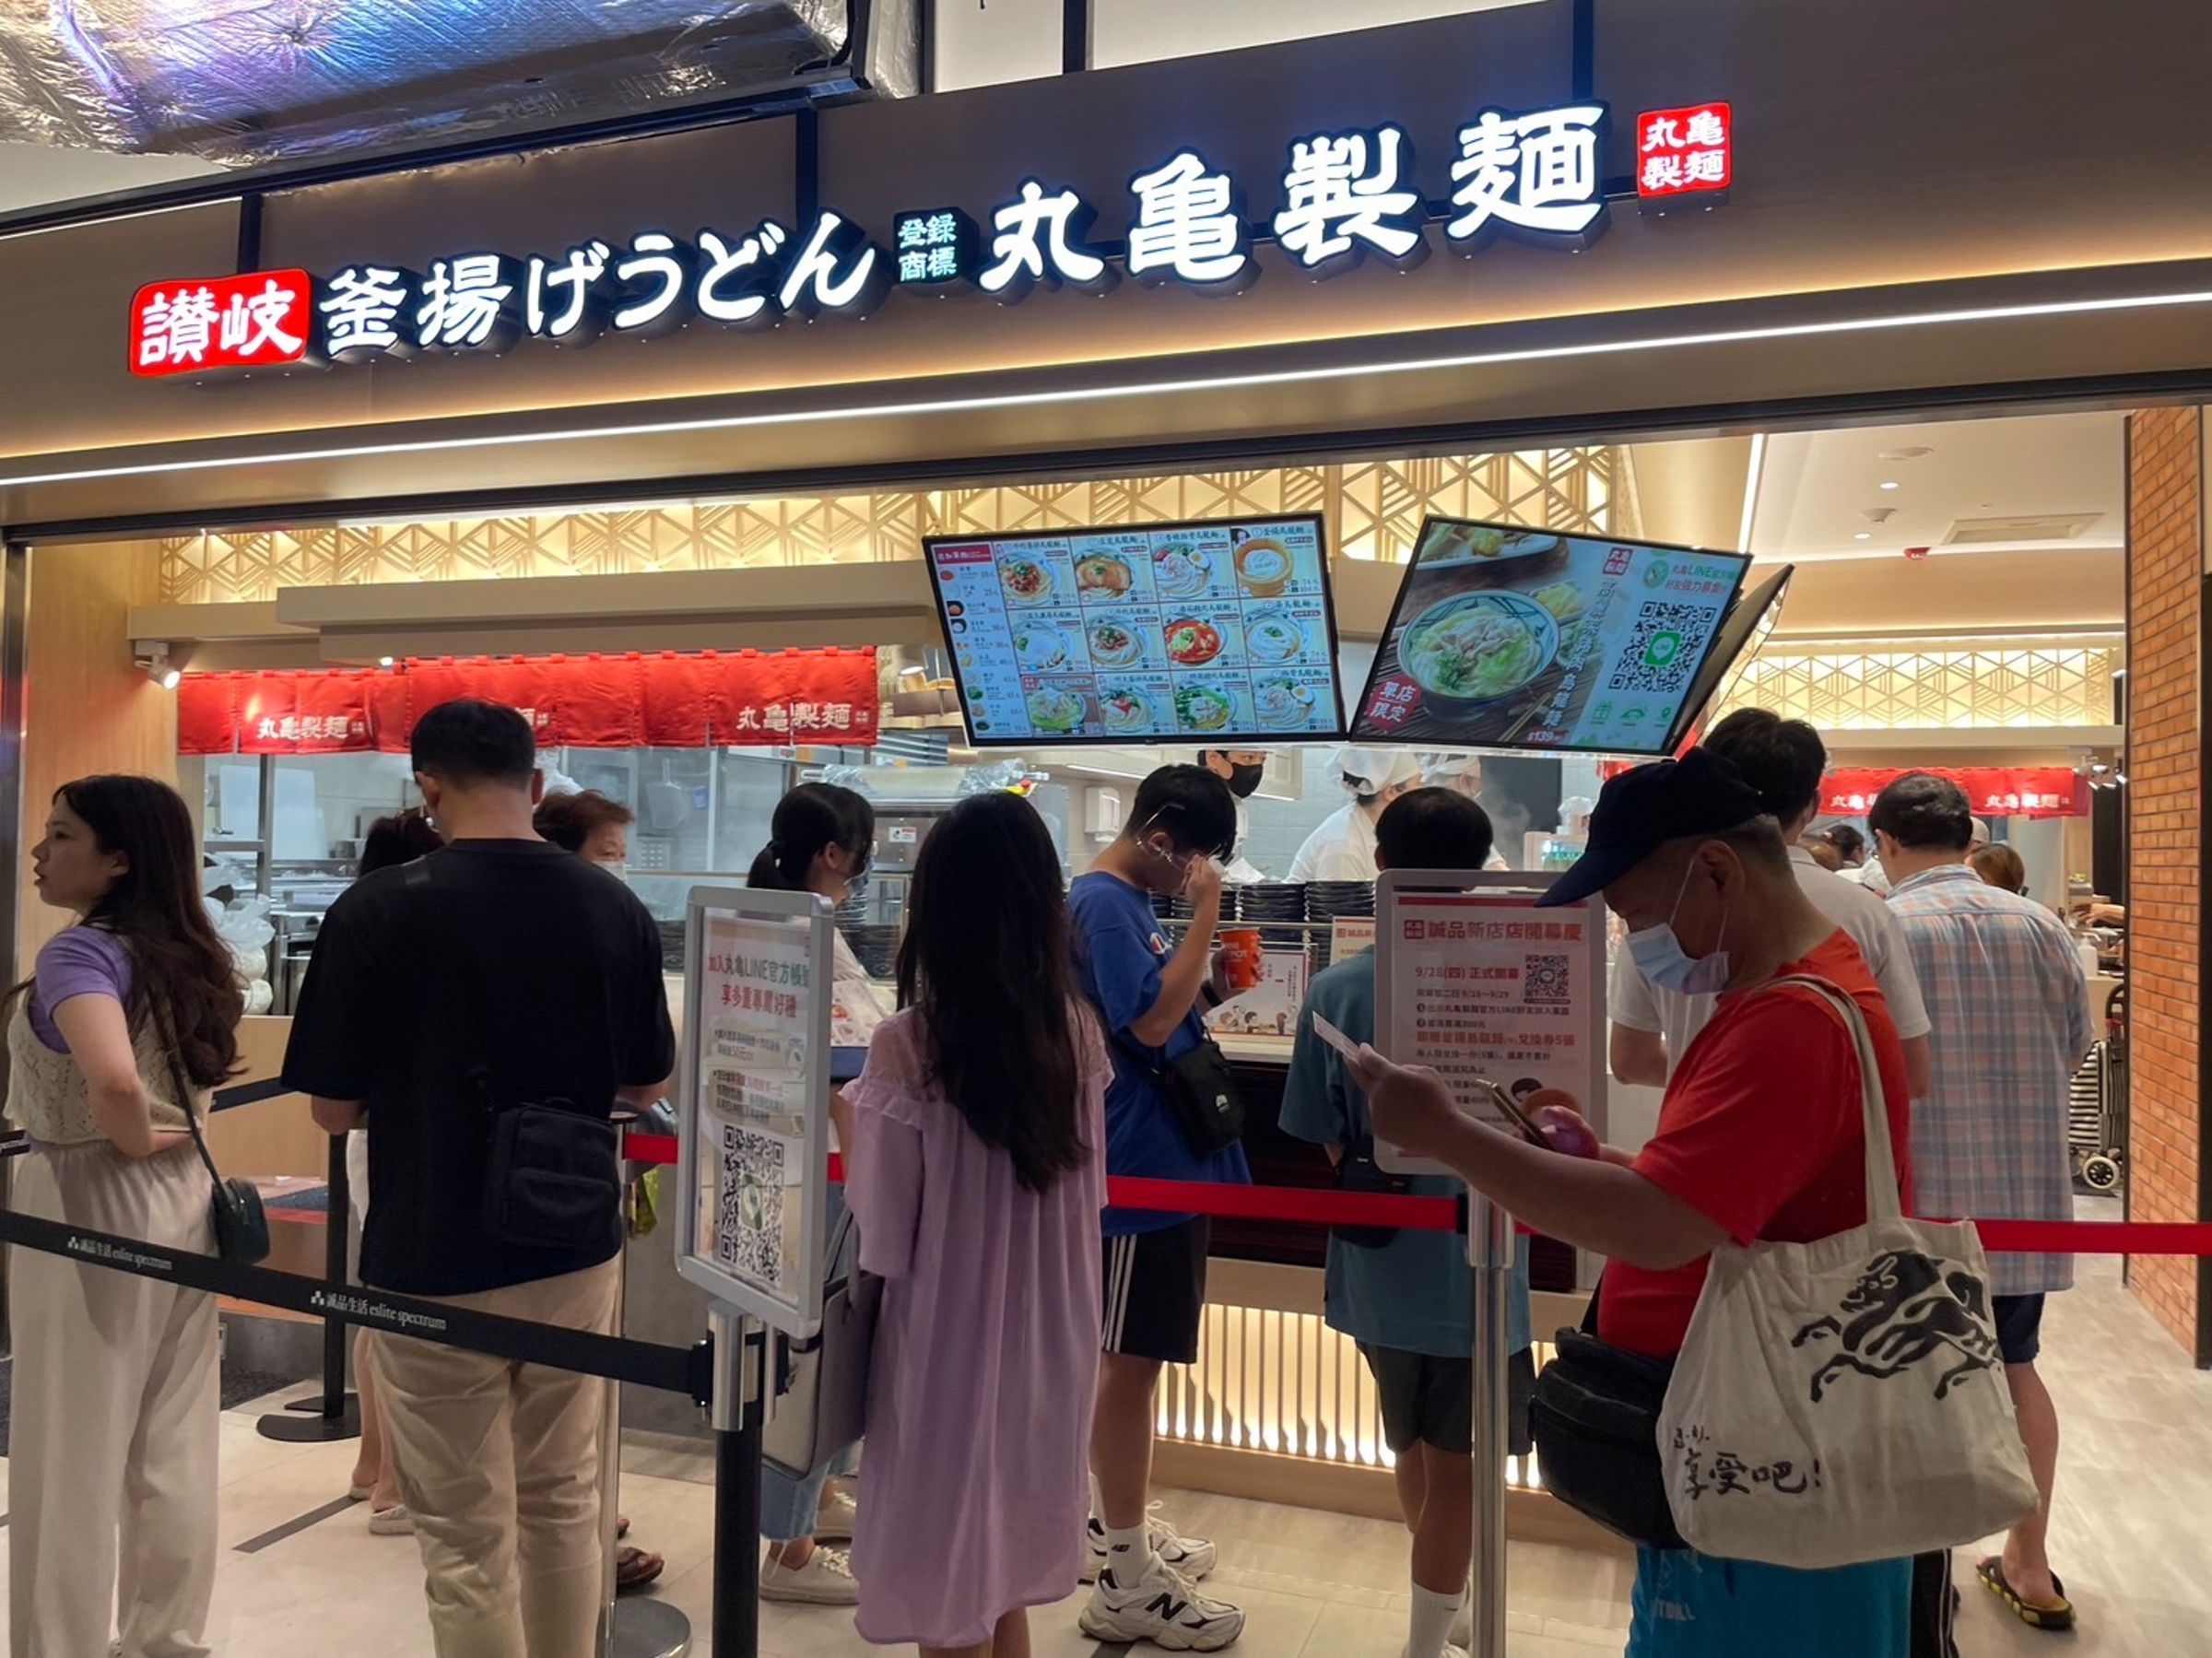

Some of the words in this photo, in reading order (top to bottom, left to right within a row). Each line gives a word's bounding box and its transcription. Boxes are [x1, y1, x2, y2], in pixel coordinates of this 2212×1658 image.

[319, 212, 876, 359] 釜揚げうどん
[369, 1302, 397, 1321] eslite
[397, 1311, 447, 1331] spectrum
